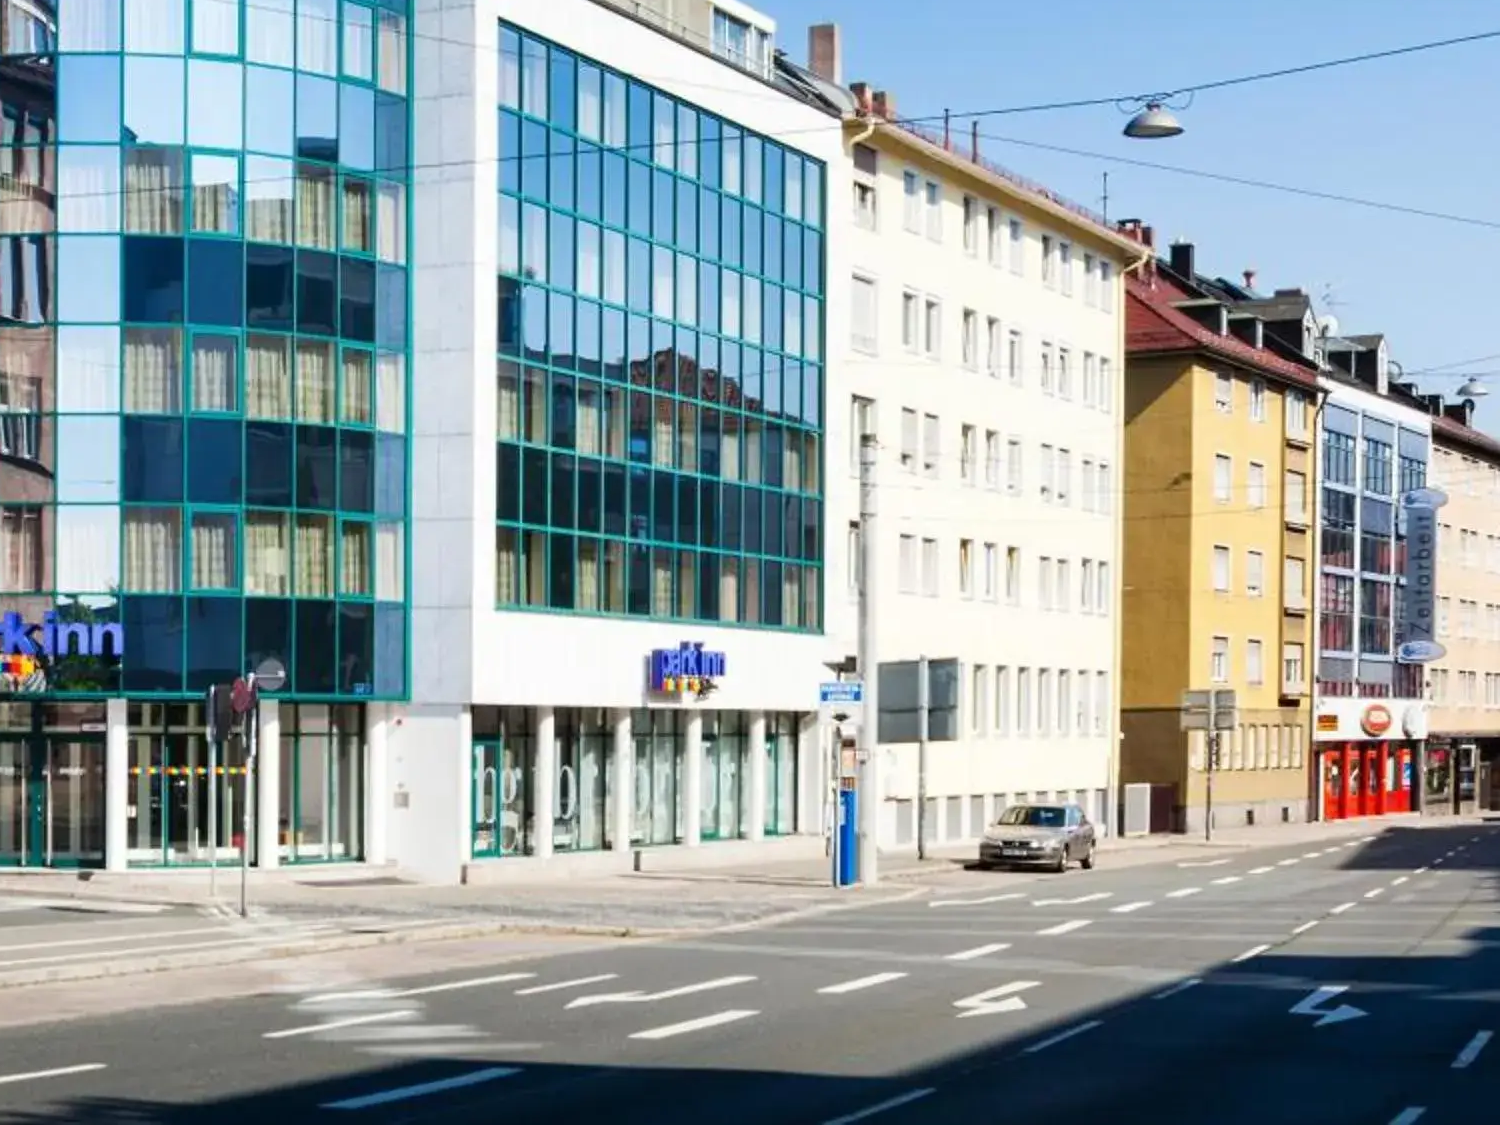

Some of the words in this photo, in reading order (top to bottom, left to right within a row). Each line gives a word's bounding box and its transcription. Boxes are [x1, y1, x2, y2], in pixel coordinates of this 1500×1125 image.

[1410, 515, 1432, 635] Zeitarbeit
[43, 611, 124, 655] inn
[652, 641, 700, 691] park
[694, 642, 726, 677] inn
